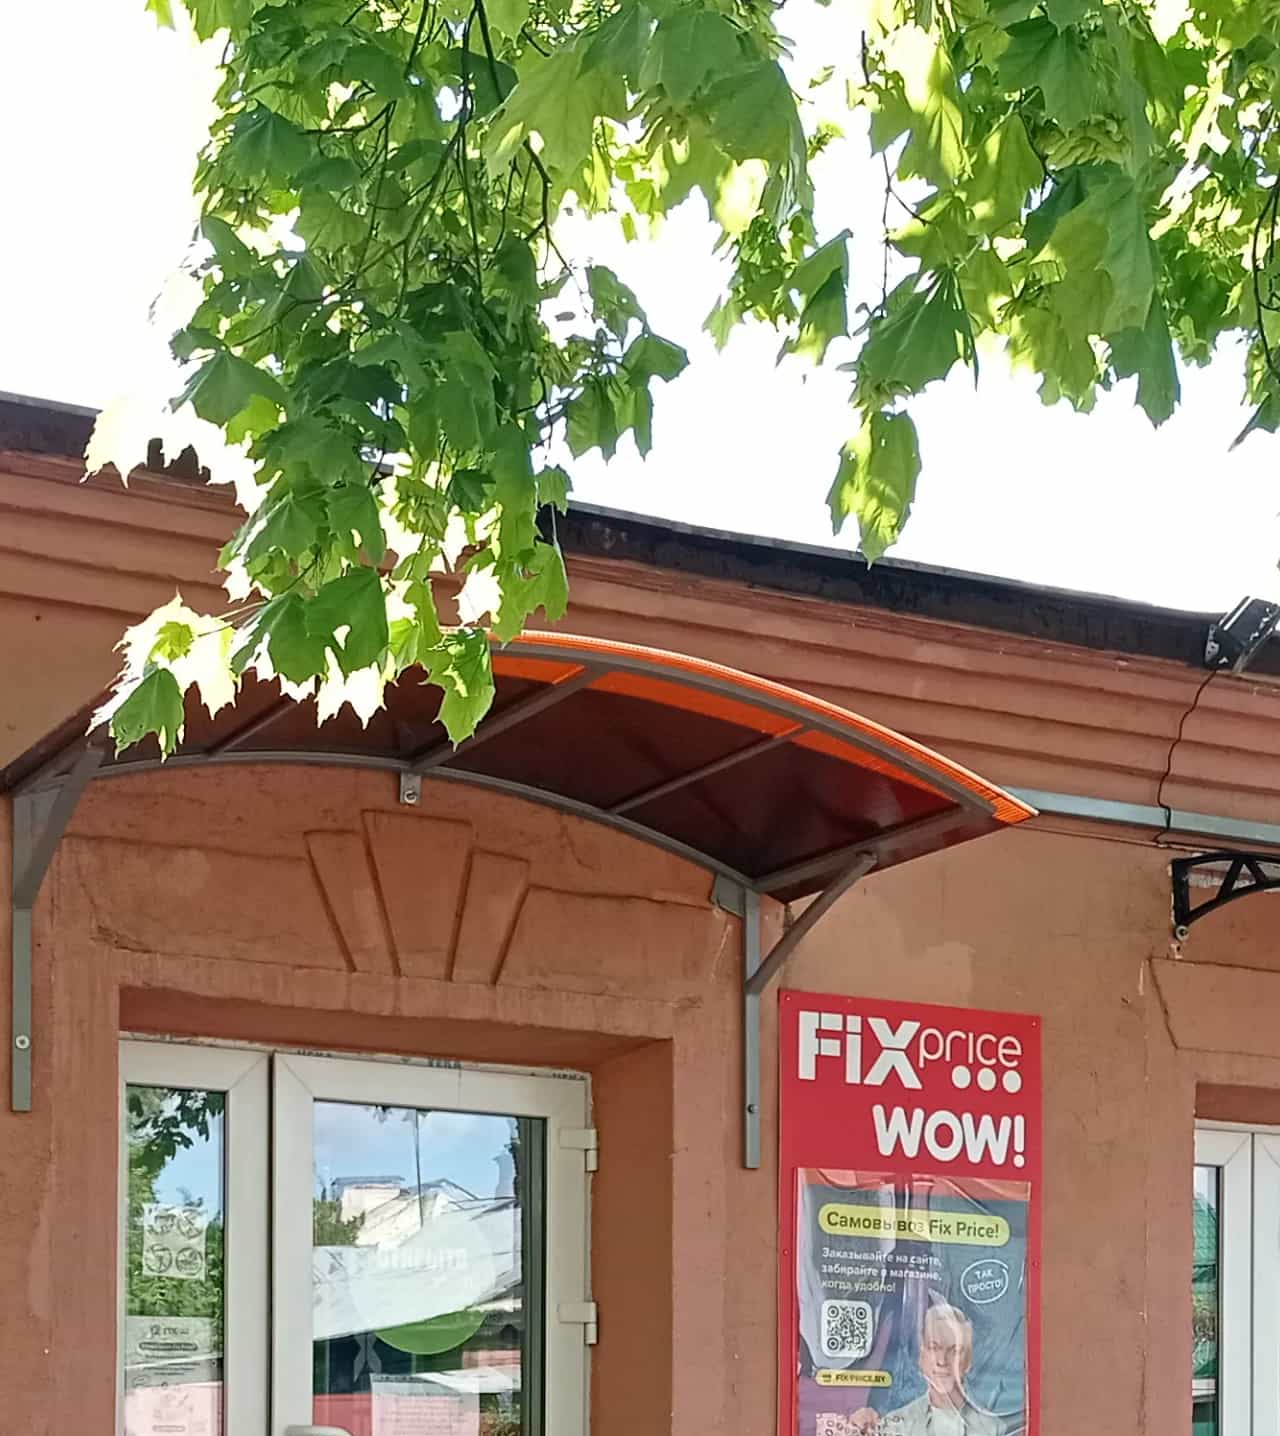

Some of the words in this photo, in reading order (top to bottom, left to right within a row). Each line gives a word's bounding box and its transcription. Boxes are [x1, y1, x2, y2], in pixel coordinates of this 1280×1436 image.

[919, 1028, 1022, 1068] price
[872, 1104, 1025, 1168] WOW!
[827, 1211, 925, 1233] Самовывоз
[929, 1219, 952, 1236] Fix
[956, 1221, 1000, 1238] Price!
